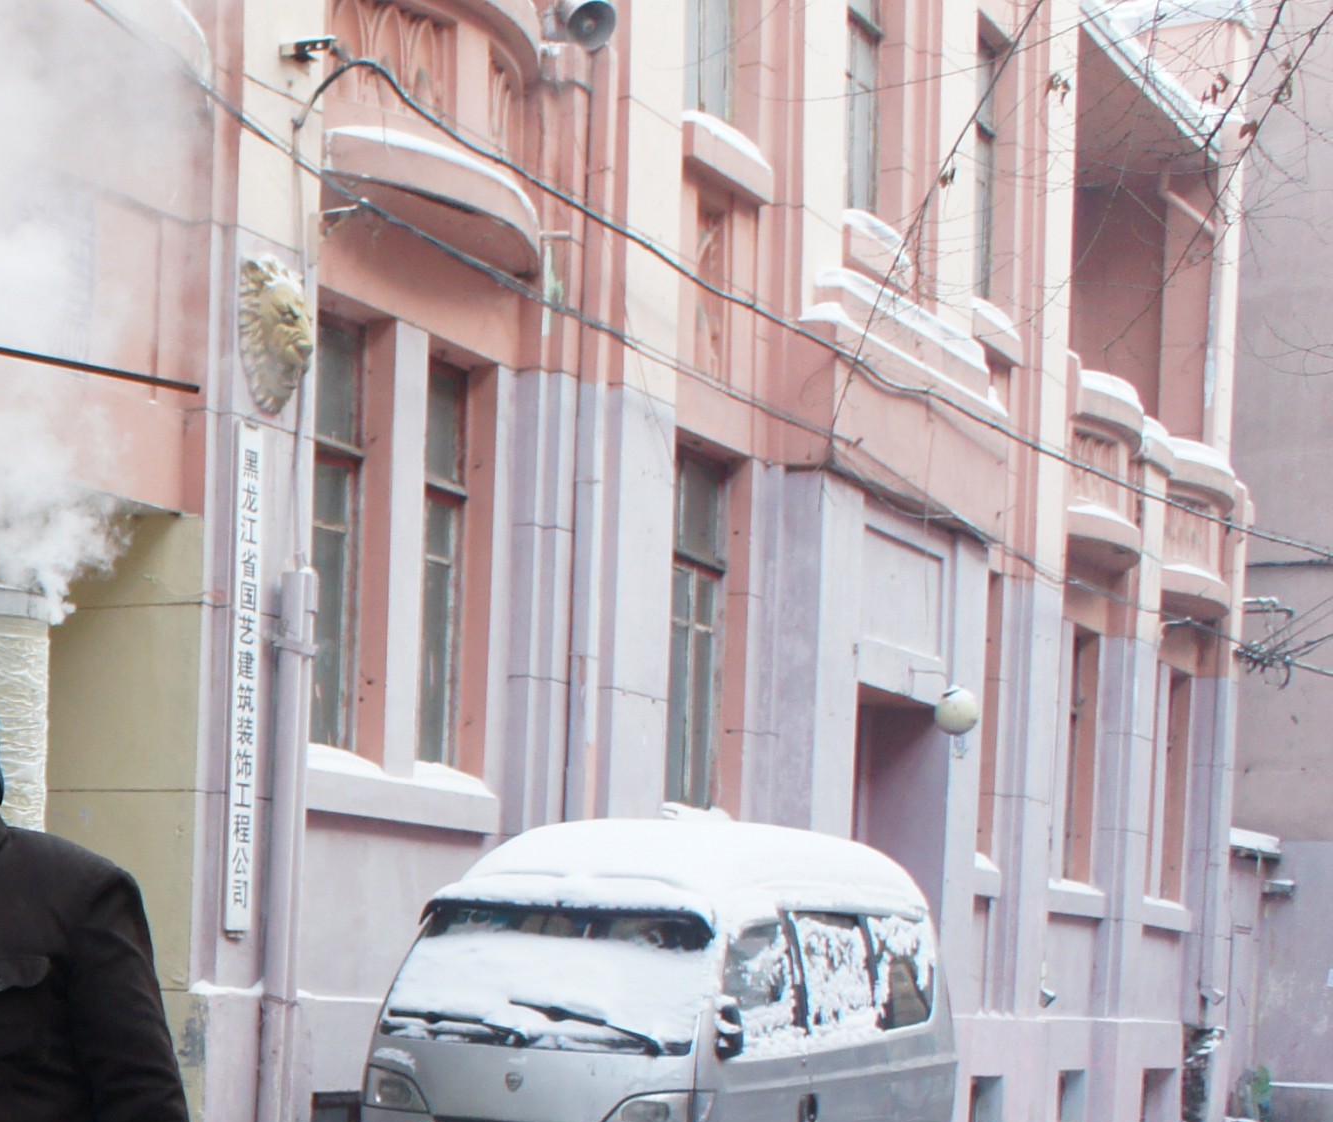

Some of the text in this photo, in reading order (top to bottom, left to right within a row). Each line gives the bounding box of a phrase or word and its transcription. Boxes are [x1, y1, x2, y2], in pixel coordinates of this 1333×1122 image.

[231, 448, 260, 909] 黑龙江省国艺建筑装饰工程公司
